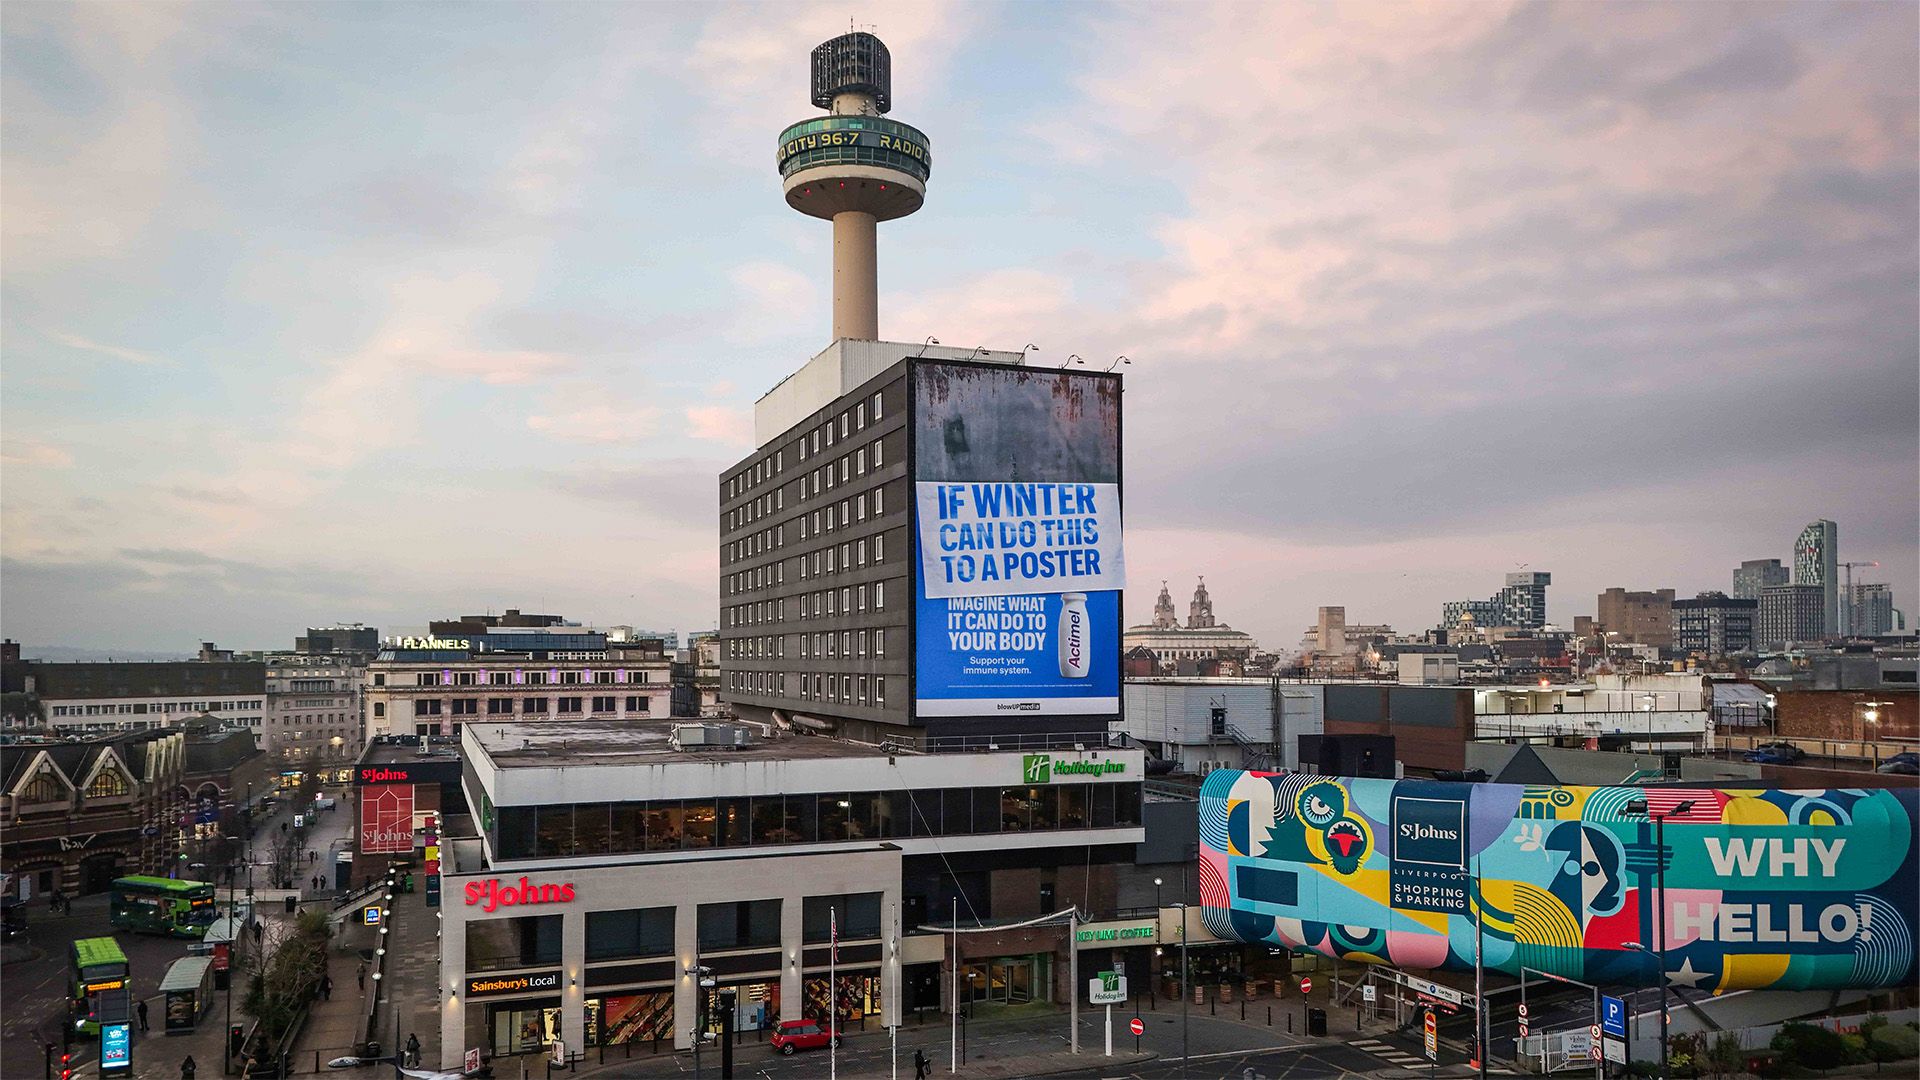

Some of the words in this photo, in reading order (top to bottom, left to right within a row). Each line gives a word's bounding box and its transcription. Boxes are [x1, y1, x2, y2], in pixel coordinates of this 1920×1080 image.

[787, 135, 816, 155] CITY
[880, 136, 922, 159] RADIO
[938, 485, 966, 520] IF
[971, 483, 1097, 519] WINTER
[939, 522, 994, 552] CAN
[1000, 520, 1036, 549] DO
[1041, 517, 1099, 546] THIS
[941, 554, 975, 583] TO
[981, 553, 999, 582] A
[1004, 549, 1101, 580] POSTER
[947, 596, 1006, 611] IMAGINE
[1008, 596, 1047, 612] WHAT
[948, 613, 963, 630] IT
[965, 612, 998, 630] CAN
[1001, 613, 1024, 630] DO
[1026, 613, 1047, 630] TO
[403, 639, 470, 650] FLANNELS
[948, 632, 996, 651] YOUR
[1000, 632, 1047, 651] BODY
[1068, 610, 1082, 669] Actimel
[970, 656, 1005, 667] Support
[1006, 657, 1026, 667] your
[963, 666, 998, 674] immune
[999, 667, 1032, 676] system.
[1053, 760, 1104, 777] Holiday
[1104, 759, 1126, 774] Inn
[1703, 837, 1847, 877] WHY
[1395, 883, 1465, 899] SHOPPING
[1395, 894, 1402, 903] &
[1406, 895, 1465, 909] PARKING
[1673, 901, 1873, 943] HELLO!
[471, 978, 528, 993] Sainsbury's
[529, 975, 556, 987] Local
[1094, 992, 1117, 1001] Holiday
[1609, 1003, 1618, 1018] P
